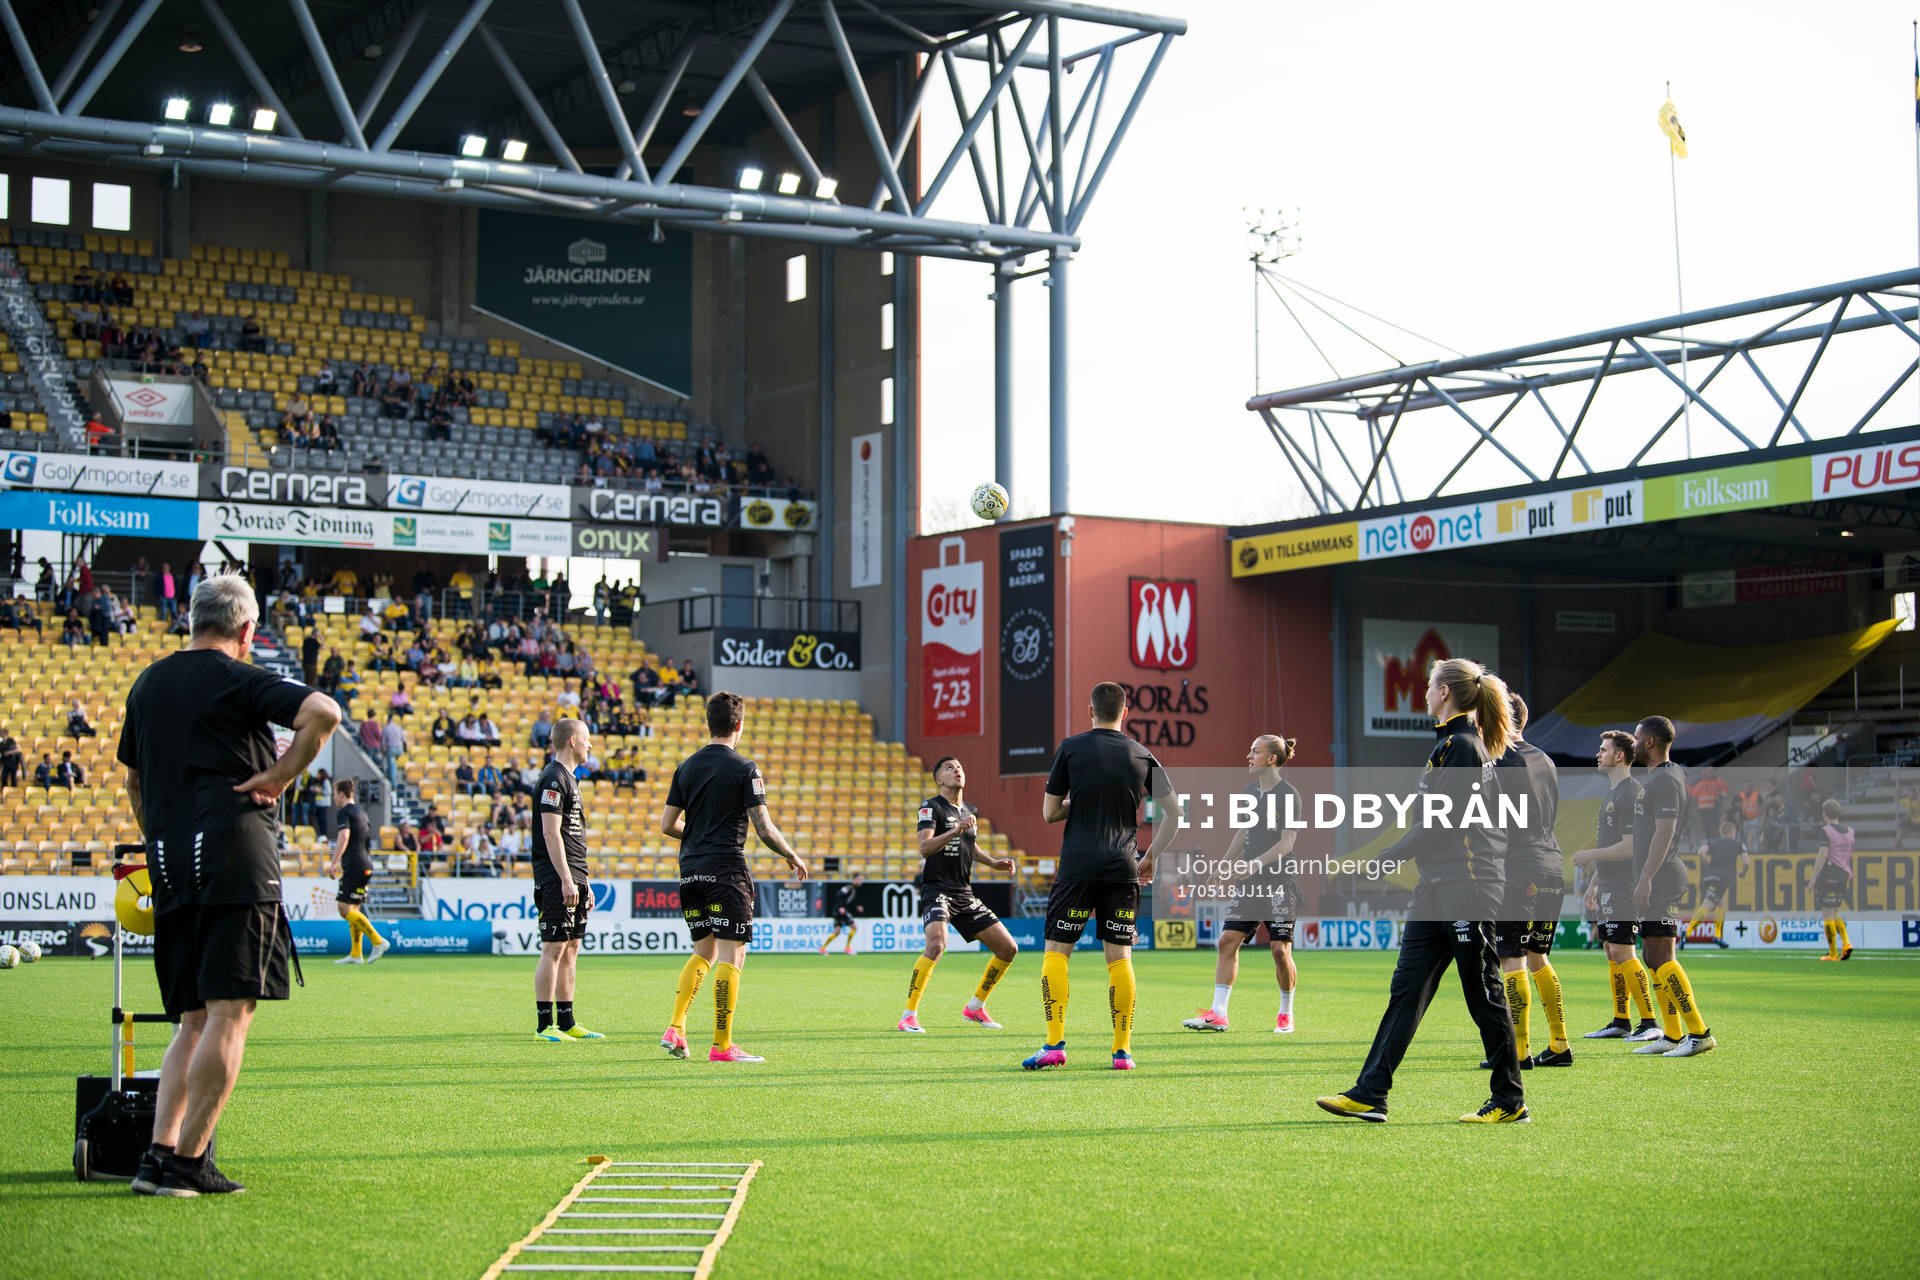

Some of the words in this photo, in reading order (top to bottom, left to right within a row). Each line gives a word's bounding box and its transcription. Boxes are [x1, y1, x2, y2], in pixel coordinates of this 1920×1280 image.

[523, 265, 651, 284] JÄRNGRINDEN
[221, 466, 367, 506] Cernera
[1682, 477, 1770, 510] Folksam
[48, 500, 151, 530] Folksam
[590, 488, 722, 526] Cernera
[215, 505, 286, 532] Borås
[288, 510, 375, 540] Tidning
[578, 528, 650, 557] onyx
[1009, 545, 1044, 561] SPABAD
[1263, 547, 1274, 560] VI
[1276, 535, 1354, 559] TILLSAMMANS
[1017, 559, 1036, 573] OCH
[1008, 573, 1045, 588] BADRUM
[927, 583, 977, 627] City
[720, 637, 787, 666] Söder
[788, 634, 817, 668] &
[814, 642, 855, 669] Co.
[932, 681, 971, 708] 7-23
[1120, 678, 1209, 714] BORÅS
[1125, 719, 1196, 747] STAD
[437, 896, 541, 920] Norde
[1069, 909, 1090, 918] EAB
[1117, 909, 1135, 919] EAB
[551, 926, 558, 935] 7
[735, 922, 746, 934] 15
[777, 925, 793, 935] AB
[1105, 920, 1137, 933] Cerner
[1321, 920, 1372, 947] TIPS
[1457, 933, 1471, 942] ML
[1667, 973, 1692, 1014] SPRINGYARD
